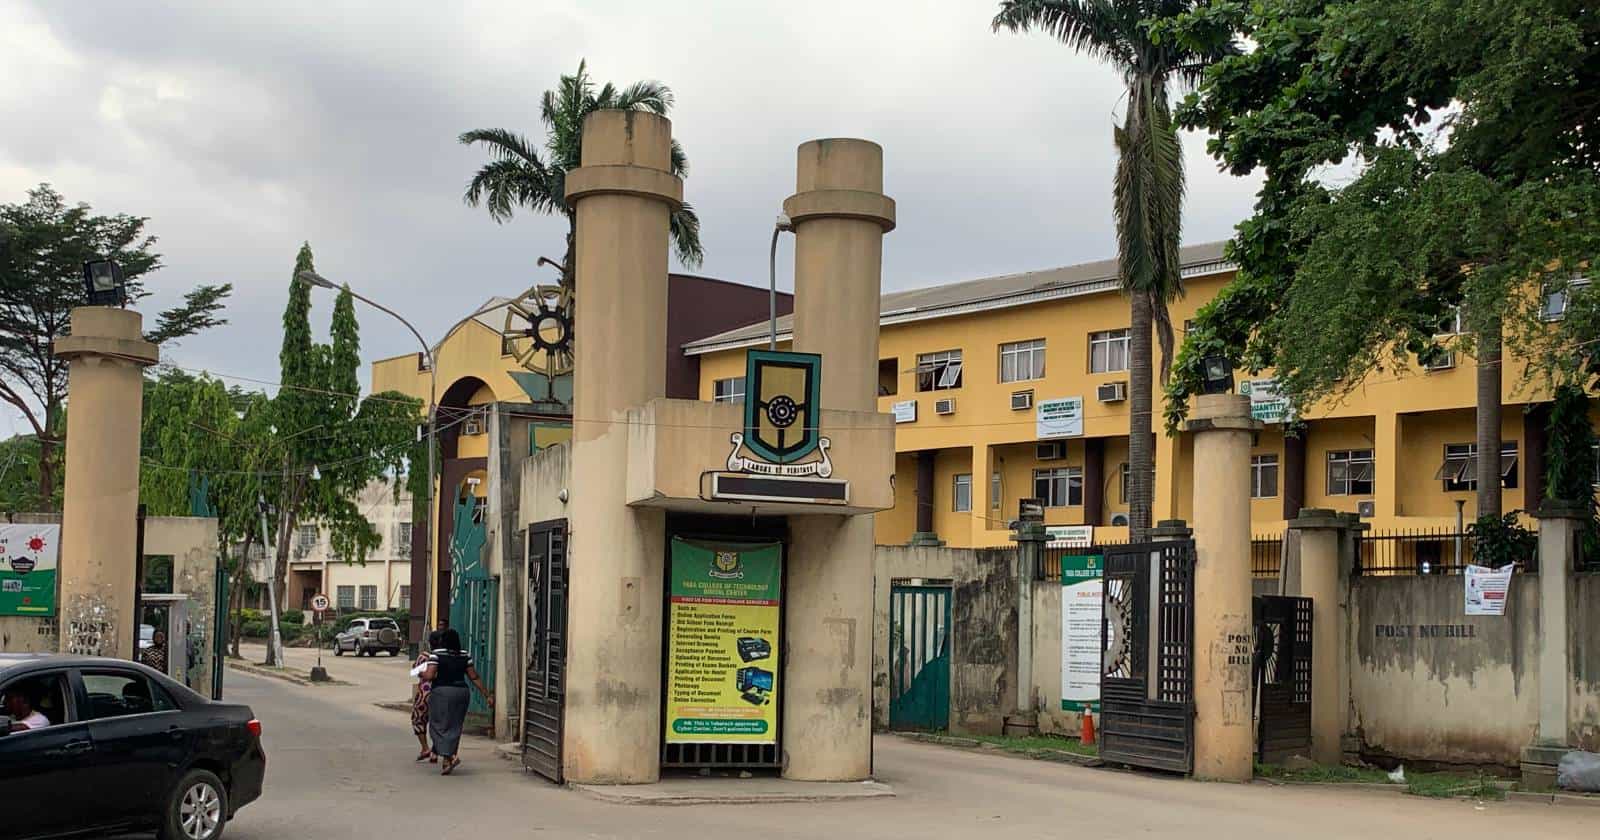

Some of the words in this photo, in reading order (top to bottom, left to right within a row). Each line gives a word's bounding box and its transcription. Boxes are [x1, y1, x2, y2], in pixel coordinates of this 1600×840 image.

[316, 598, 326, 608] 15
[1376, 624, 1412, 638] POST
[1419, 624, 1440, 638] NO
[1234, 645, 1248, 654] NO
